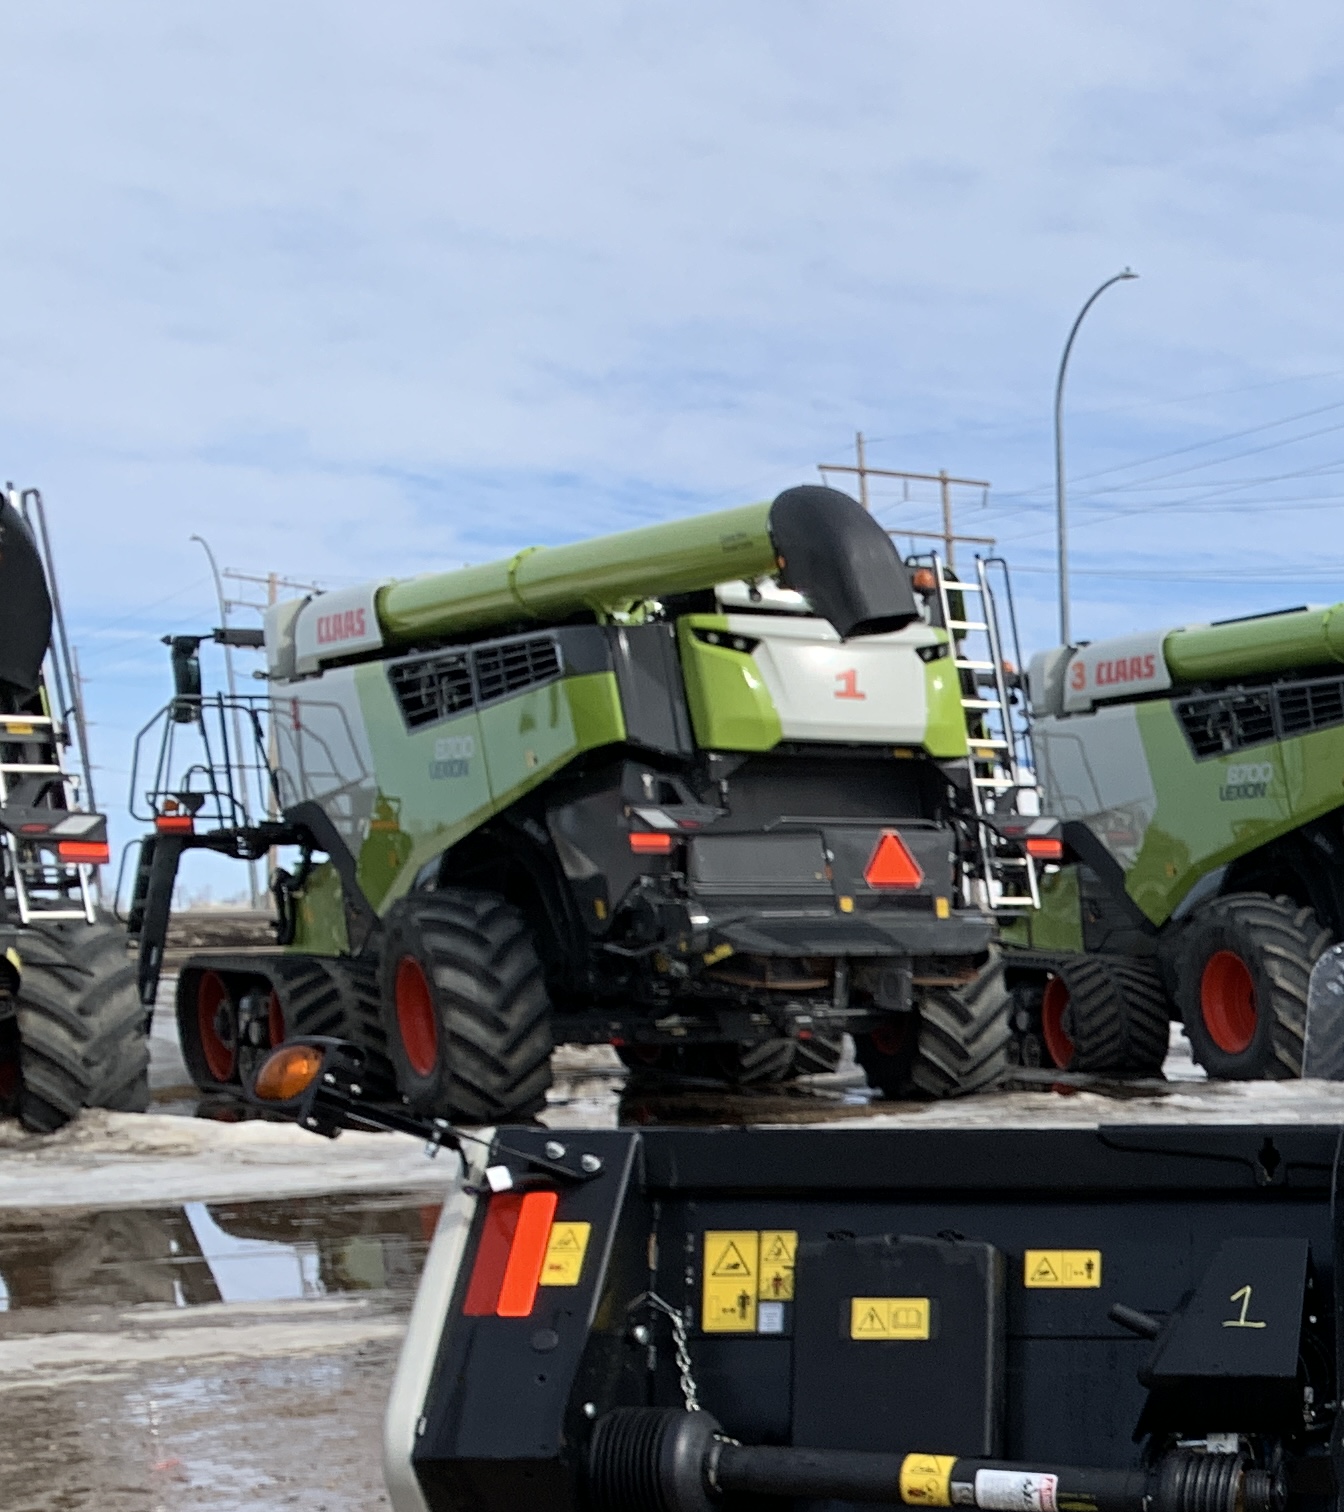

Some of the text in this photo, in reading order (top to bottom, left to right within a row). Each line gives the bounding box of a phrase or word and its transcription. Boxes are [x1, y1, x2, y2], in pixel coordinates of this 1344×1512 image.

[317, 608, 366, 645] CLAAS
[833, 668, 867, 701] 1
[1071, 654, 1155, 691] 3 CLAAS
[1219, 782, 1267, 802] LEXION
[1221, 1285, 1267, 1329] 1
